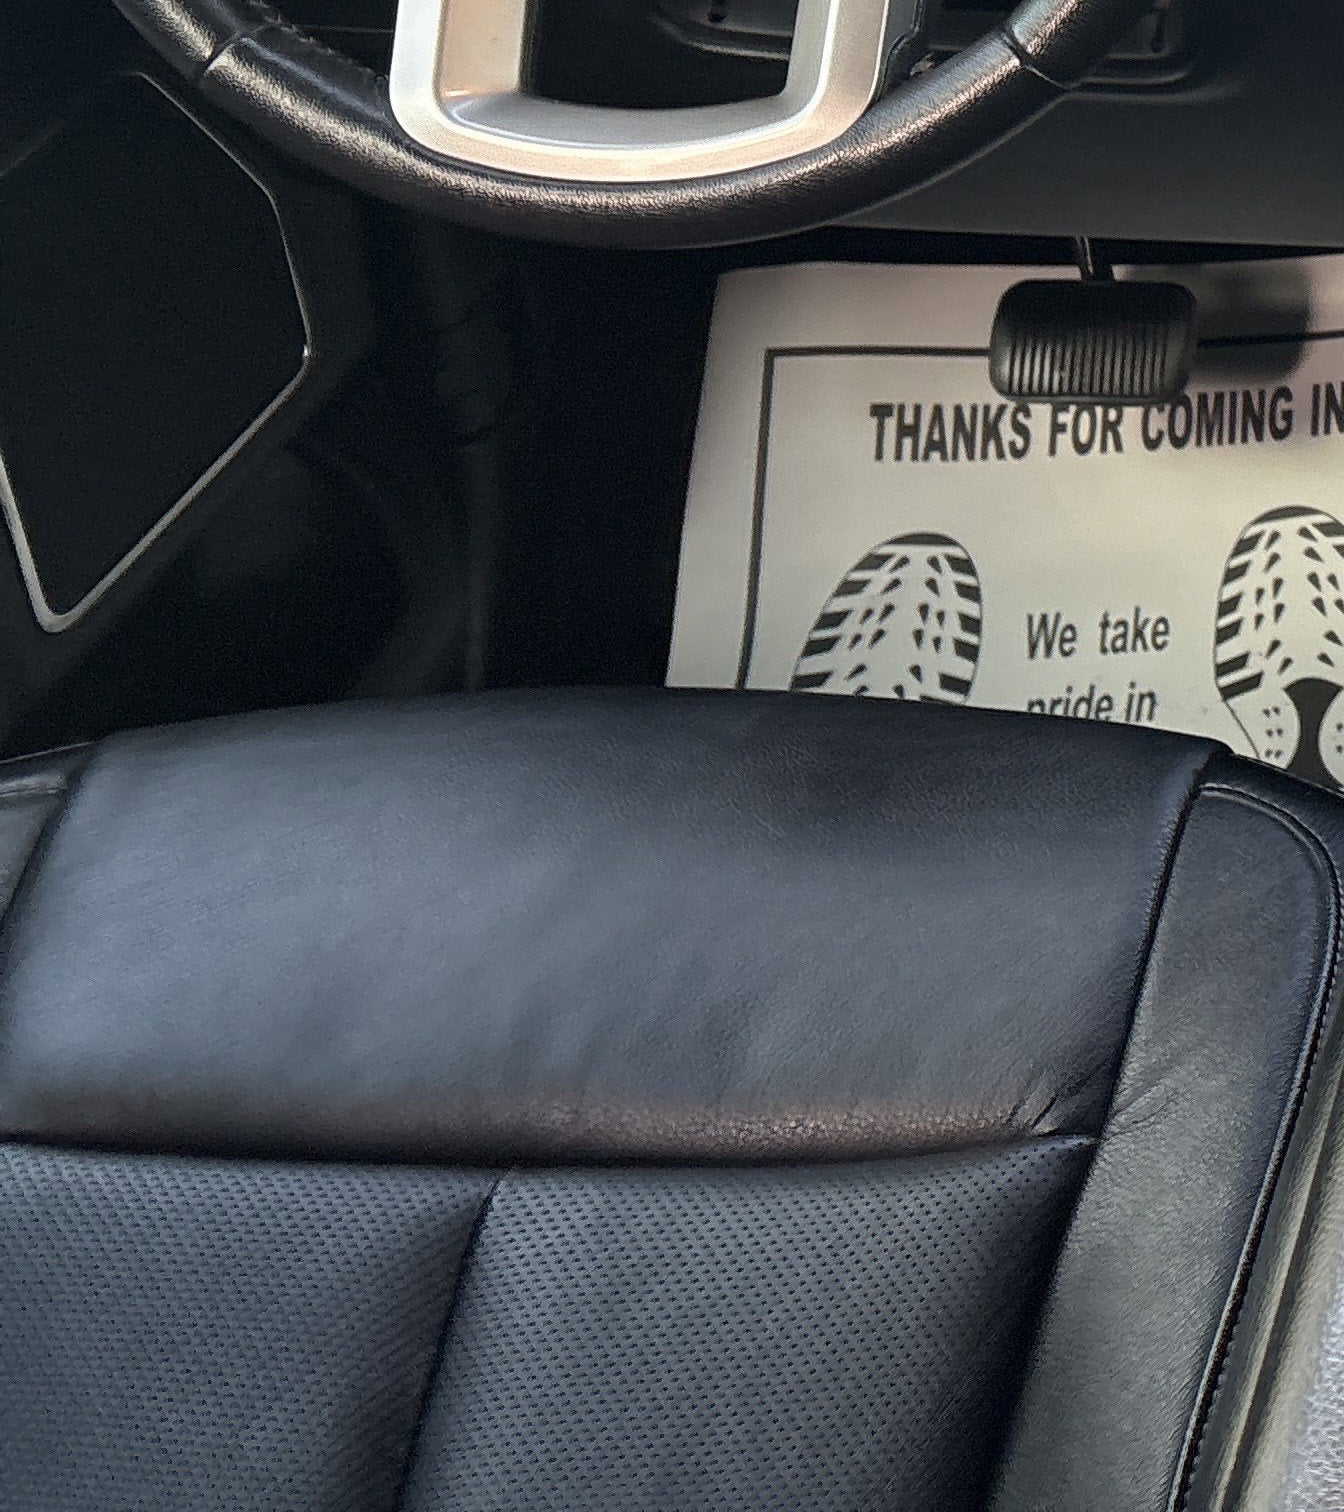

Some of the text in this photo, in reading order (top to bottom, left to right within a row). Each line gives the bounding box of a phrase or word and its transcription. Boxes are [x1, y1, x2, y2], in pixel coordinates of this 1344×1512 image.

[869, 400, 1032, 464] THANKS
[1047, 403, 1126, 456] FOR
[1140, 384, 1294, 453] COMING
[1026, 607, 1172, 661] We take
[1124, 679, 1157, 724] in
